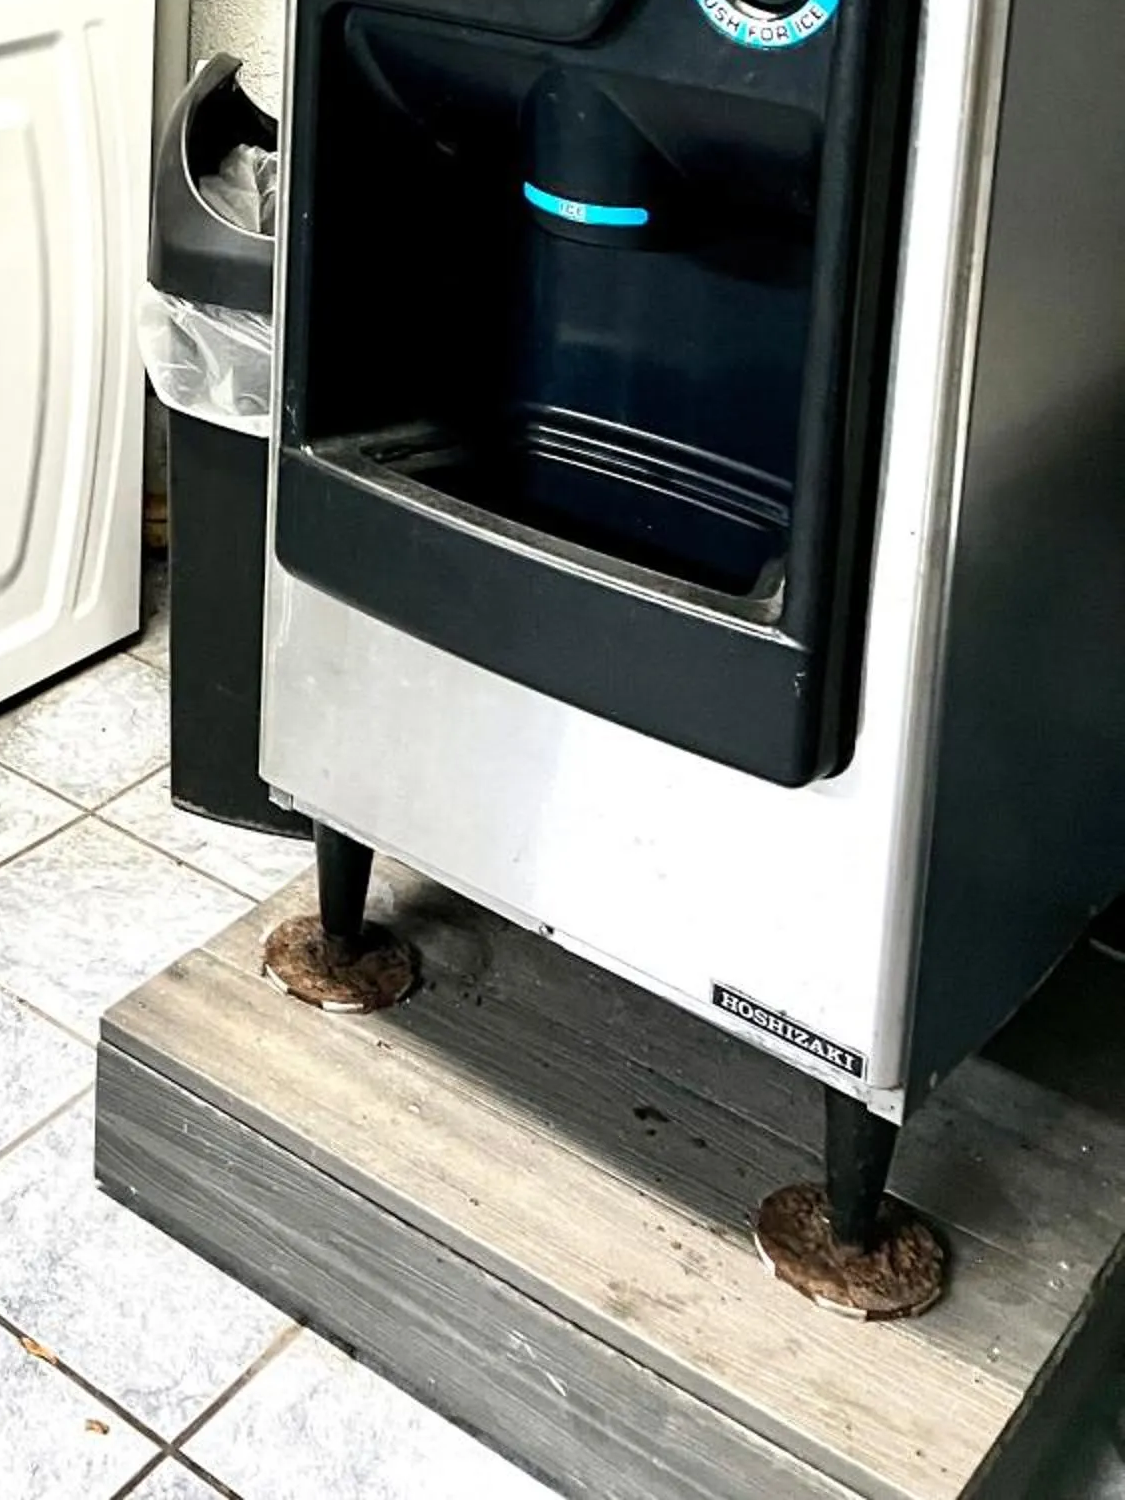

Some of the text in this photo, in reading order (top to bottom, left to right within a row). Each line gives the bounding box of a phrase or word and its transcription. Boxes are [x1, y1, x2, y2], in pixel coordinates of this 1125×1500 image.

[747, 24, 790, 42] FOR
[795, 7, 825, 33] ICE
[560, 202, 585, 217] ICE
[721, 991, 856, 1071] HOSHIZAKI
